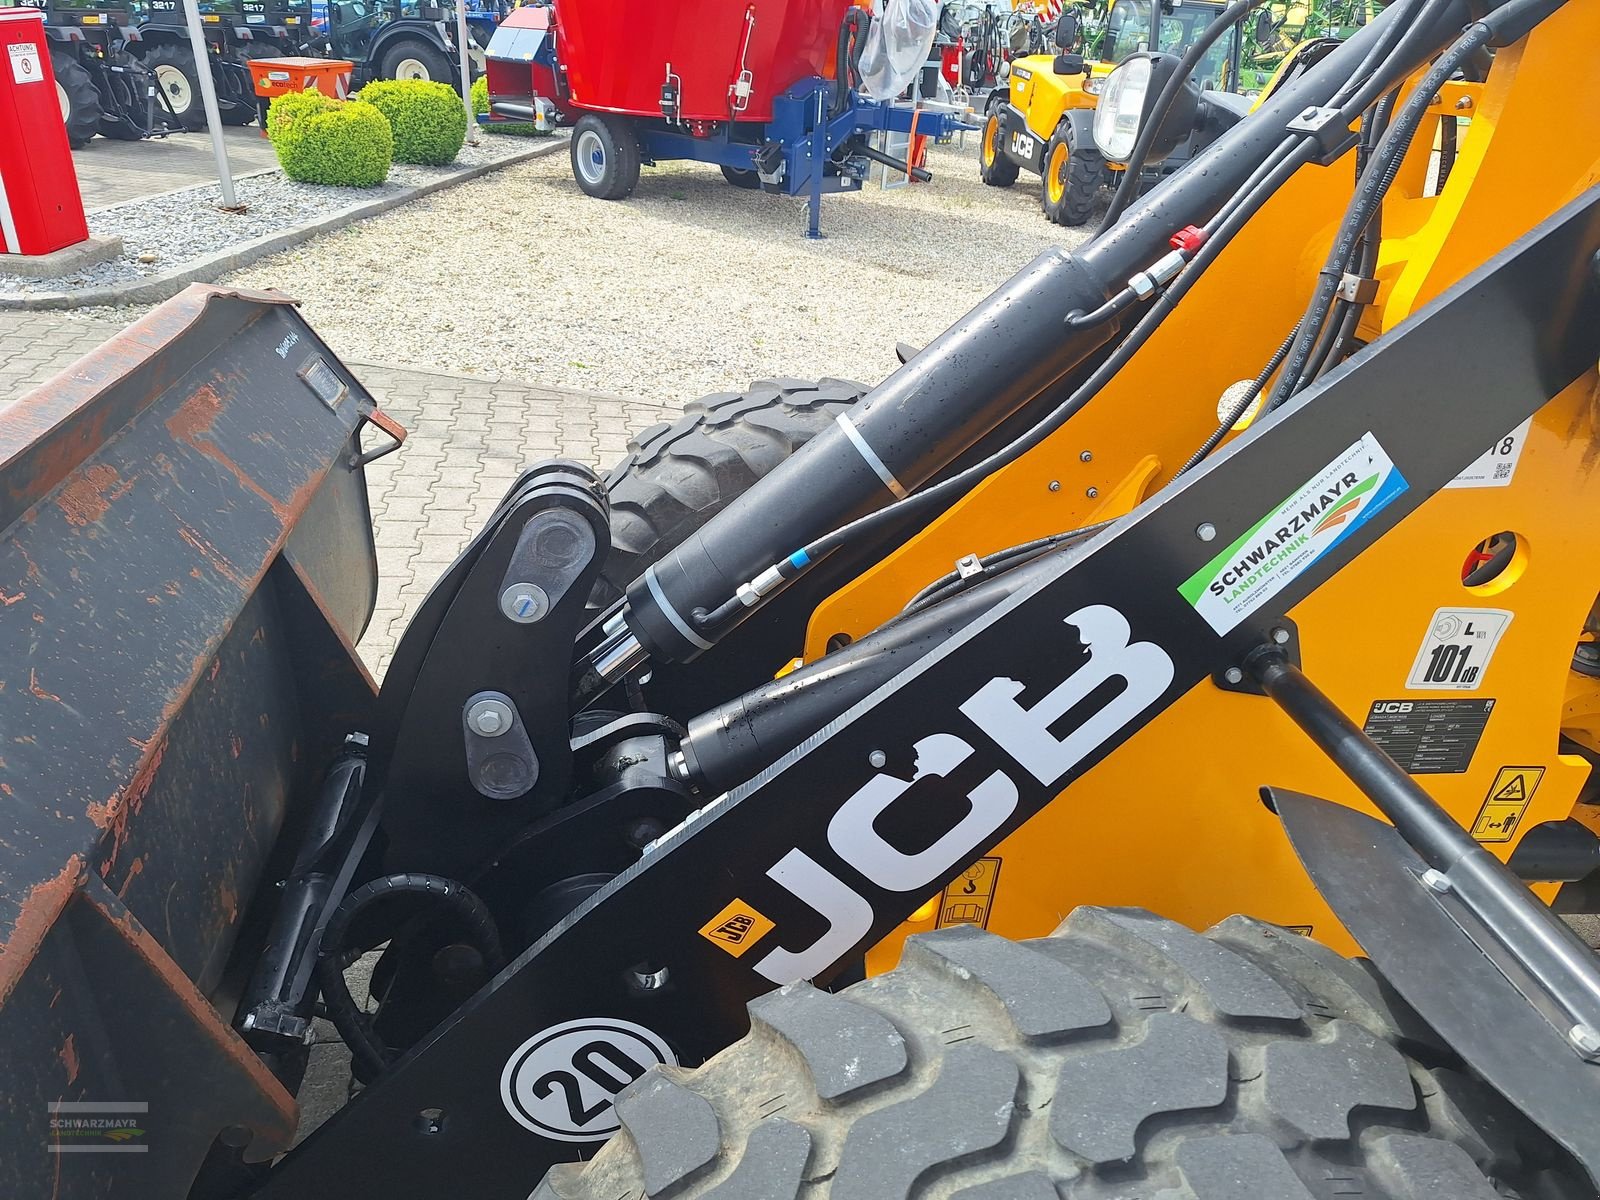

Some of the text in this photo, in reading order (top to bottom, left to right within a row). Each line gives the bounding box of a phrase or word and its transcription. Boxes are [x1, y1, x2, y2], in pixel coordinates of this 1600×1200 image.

[153, 1, 175, 10] 3217
[243, 4, 264, 12] 3217
[1012, 131, 1034, 160] JCB
[1292, 354, 1303, 367] SAE
[1344, 231, 1352, 242] bar
[1411, 89, 1428, 107] MSHA
[1281, 500, 1298, 515] MEHR
[1299, 489, 1310, 500] ALS
[1311, 478, 1324, 490] NUR
[1208, 470, 1359, 596] SCHWARZMAYR
[1222, 532, 1309, 604] LANDTECHNIK
[1423, 644, 1480, 683] 101 dB
[1373, 702, 1413, 713] JCB
[752, 604, 1175, 986] JCB
[716, 917, 752, 941] JCB
[532, 1040, 647, 1127] 20
